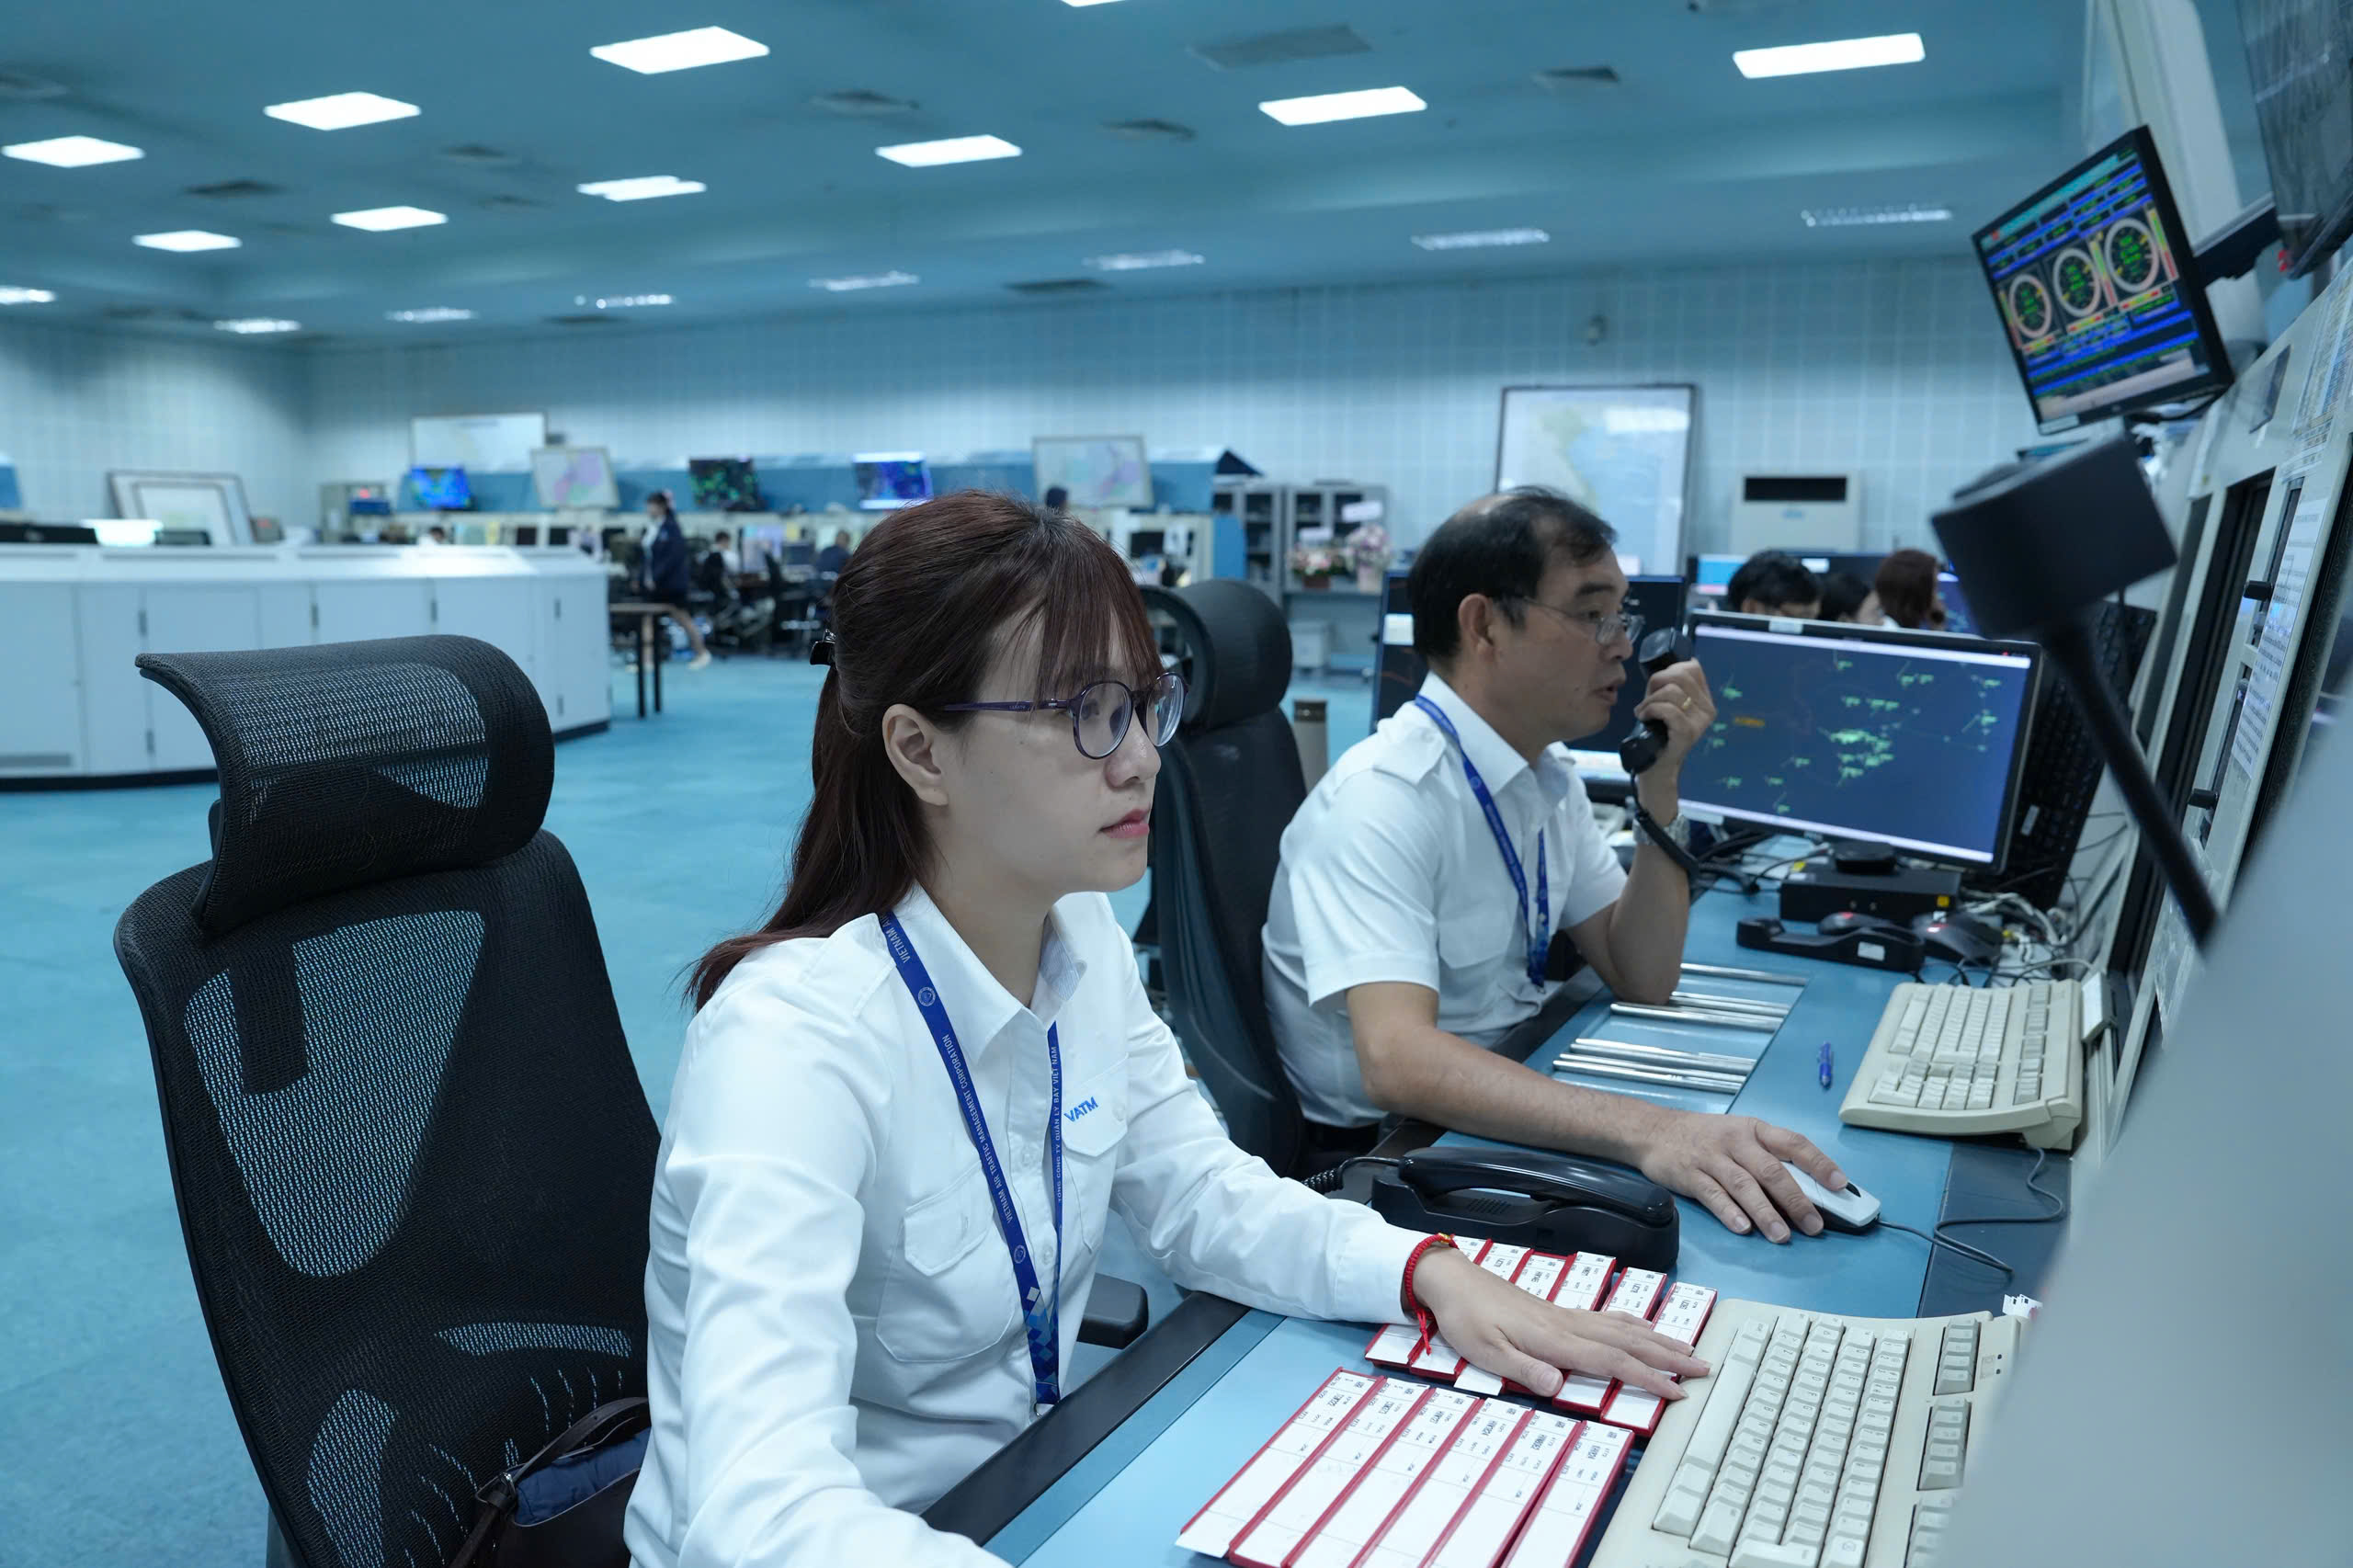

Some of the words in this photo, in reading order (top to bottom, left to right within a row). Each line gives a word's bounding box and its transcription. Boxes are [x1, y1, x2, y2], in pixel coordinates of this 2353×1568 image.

[886, 926, 911, 964] VIETNAM
[942, 1034, 966, 1089] CORPORATION
[963, 1090, 986, 1142] MANAGEMENT
[1063, 1096, 1098, 1122] VATM
[982, 1142, 998, 1176] TRAFFIC
[992, 1175, 1003, 1190] AIR
[997, 1189, 1013, 1223] VIETNAM
